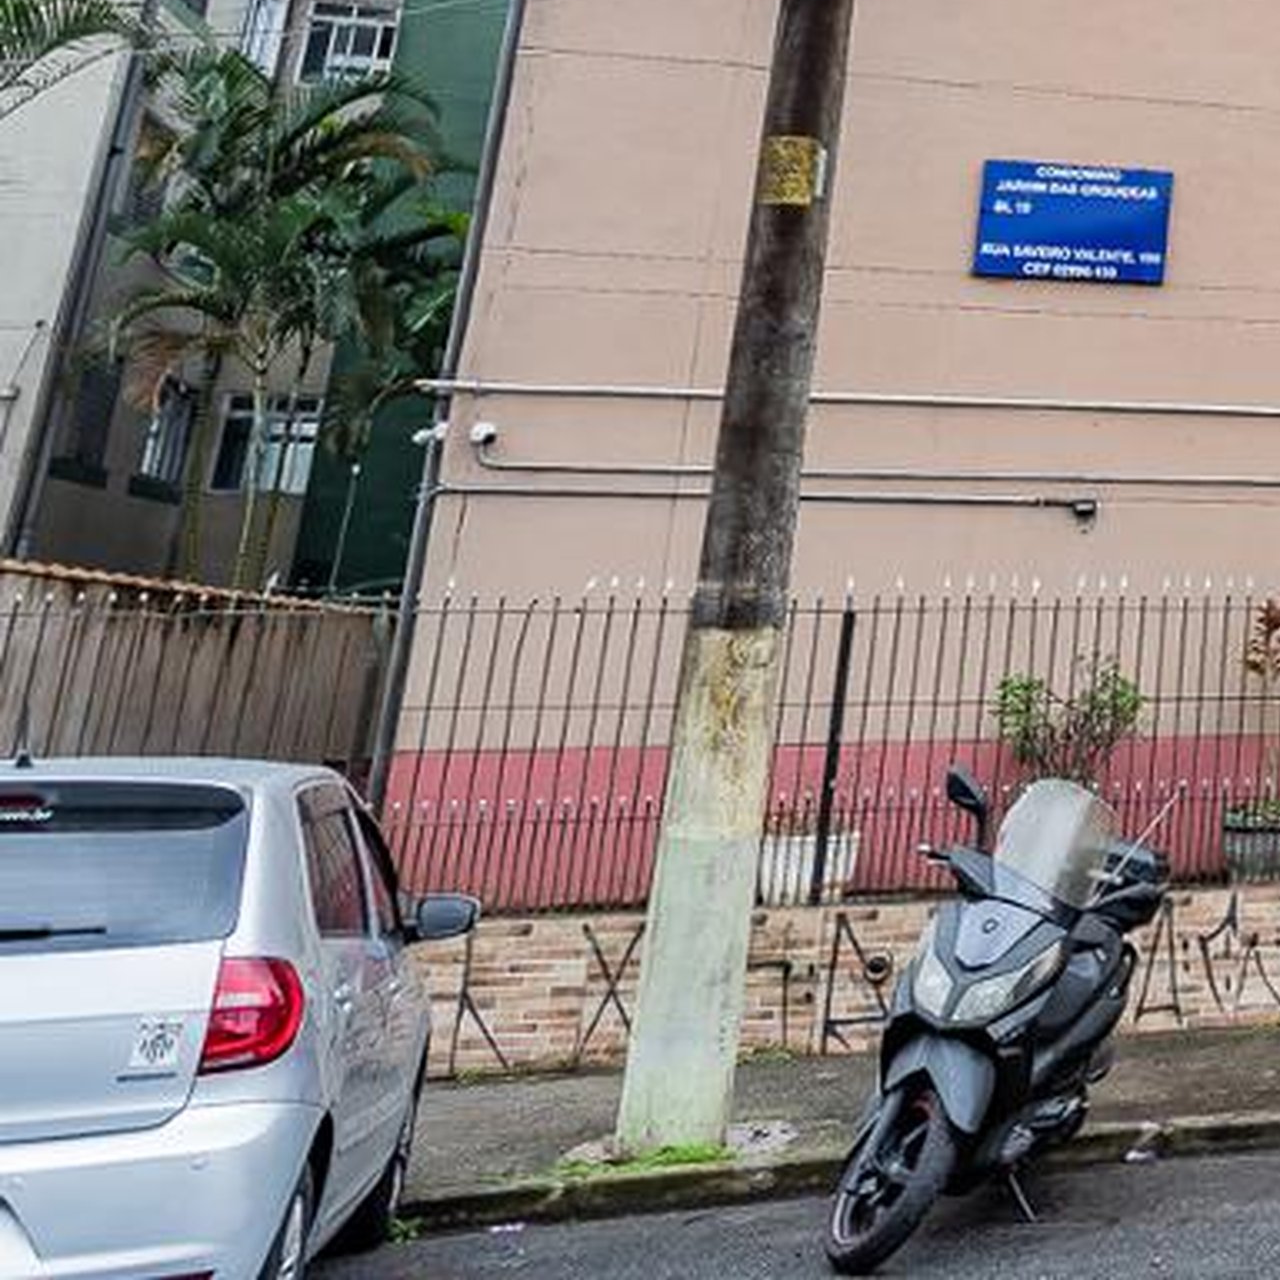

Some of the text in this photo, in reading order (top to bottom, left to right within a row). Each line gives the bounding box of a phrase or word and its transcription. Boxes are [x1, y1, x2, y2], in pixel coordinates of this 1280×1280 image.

[1049, 182, 1077, 196] DAS
[981, 243, 1010, 257] RUA
[1022, 261, 1050, 276] CEP
